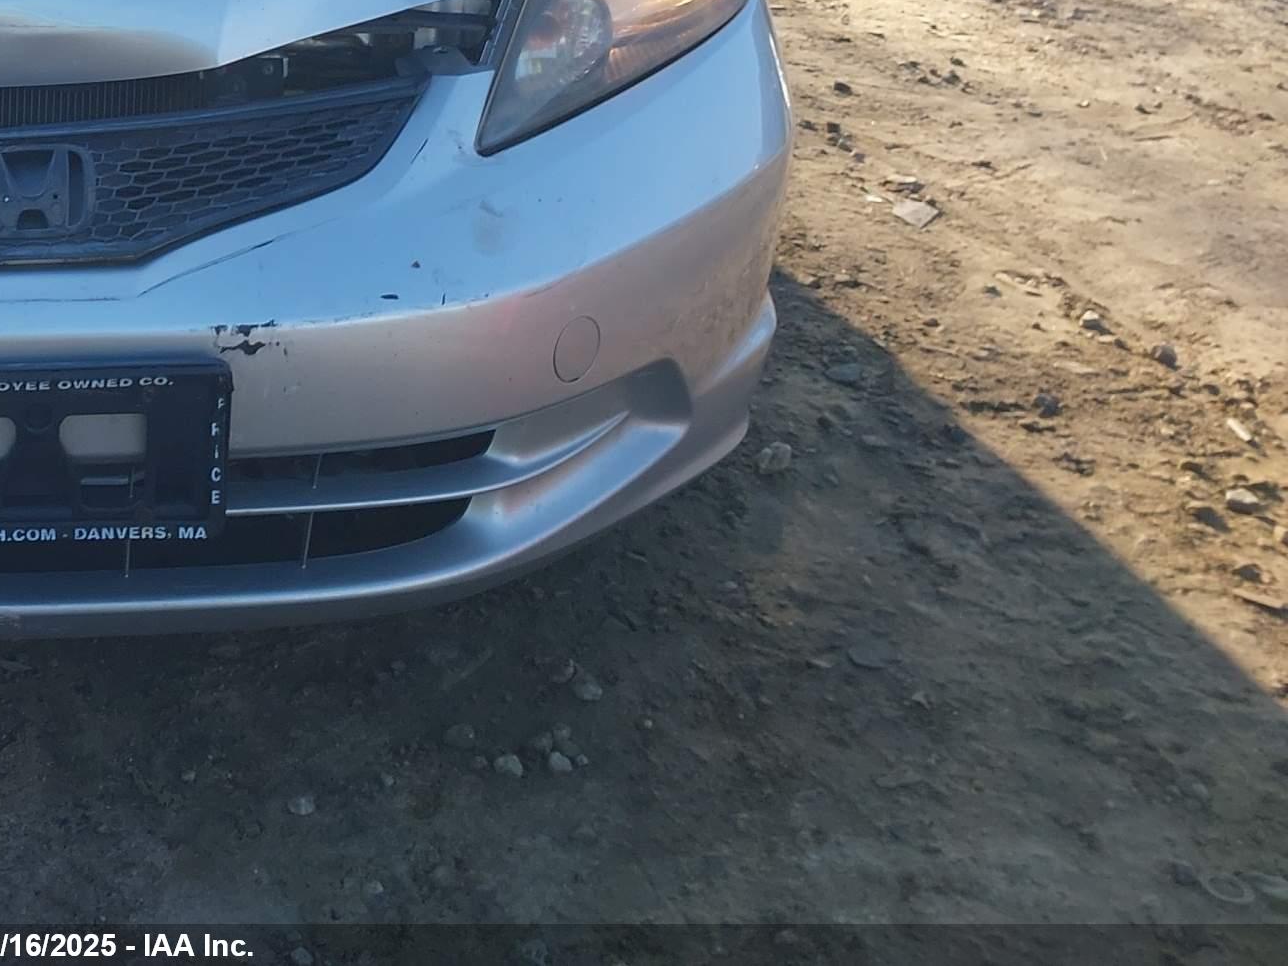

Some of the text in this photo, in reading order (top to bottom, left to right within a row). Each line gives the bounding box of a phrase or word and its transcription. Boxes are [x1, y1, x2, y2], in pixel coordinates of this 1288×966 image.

[57, 378, 133, 390] OWNED
[139, 377, 174, 386] CO.
[74, 526, 173, 541] DANVERS,
[178, 526, 208, 540] MA
